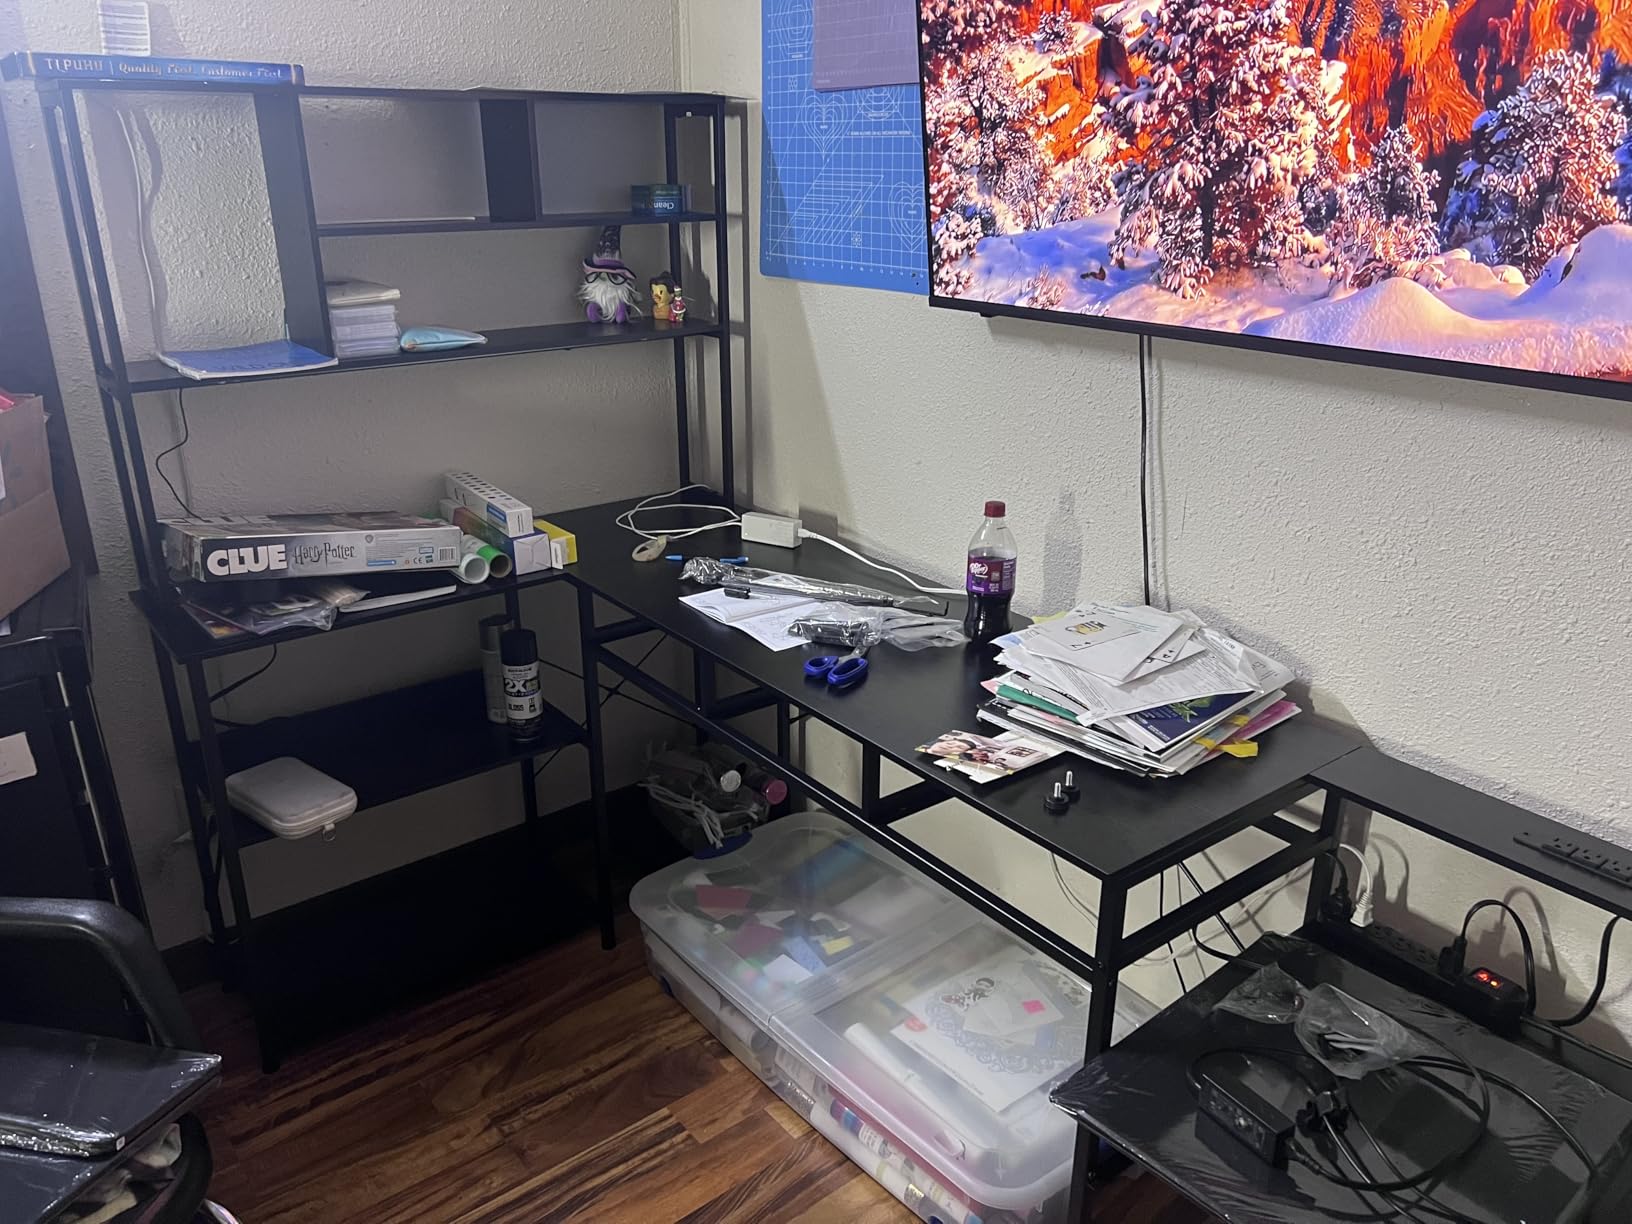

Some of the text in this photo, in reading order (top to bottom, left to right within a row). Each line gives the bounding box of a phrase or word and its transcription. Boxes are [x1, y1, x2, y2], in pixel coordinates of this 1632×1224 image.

[119, 63, 161, 76] Quality
[653, 201, 675, 210] Clean
[207, 544, 288, 576] CLUE
[293, 545, 322, 565] Harry
[323, 542, 355, 568] Potter
[505, 679, 527, 692] 2X
